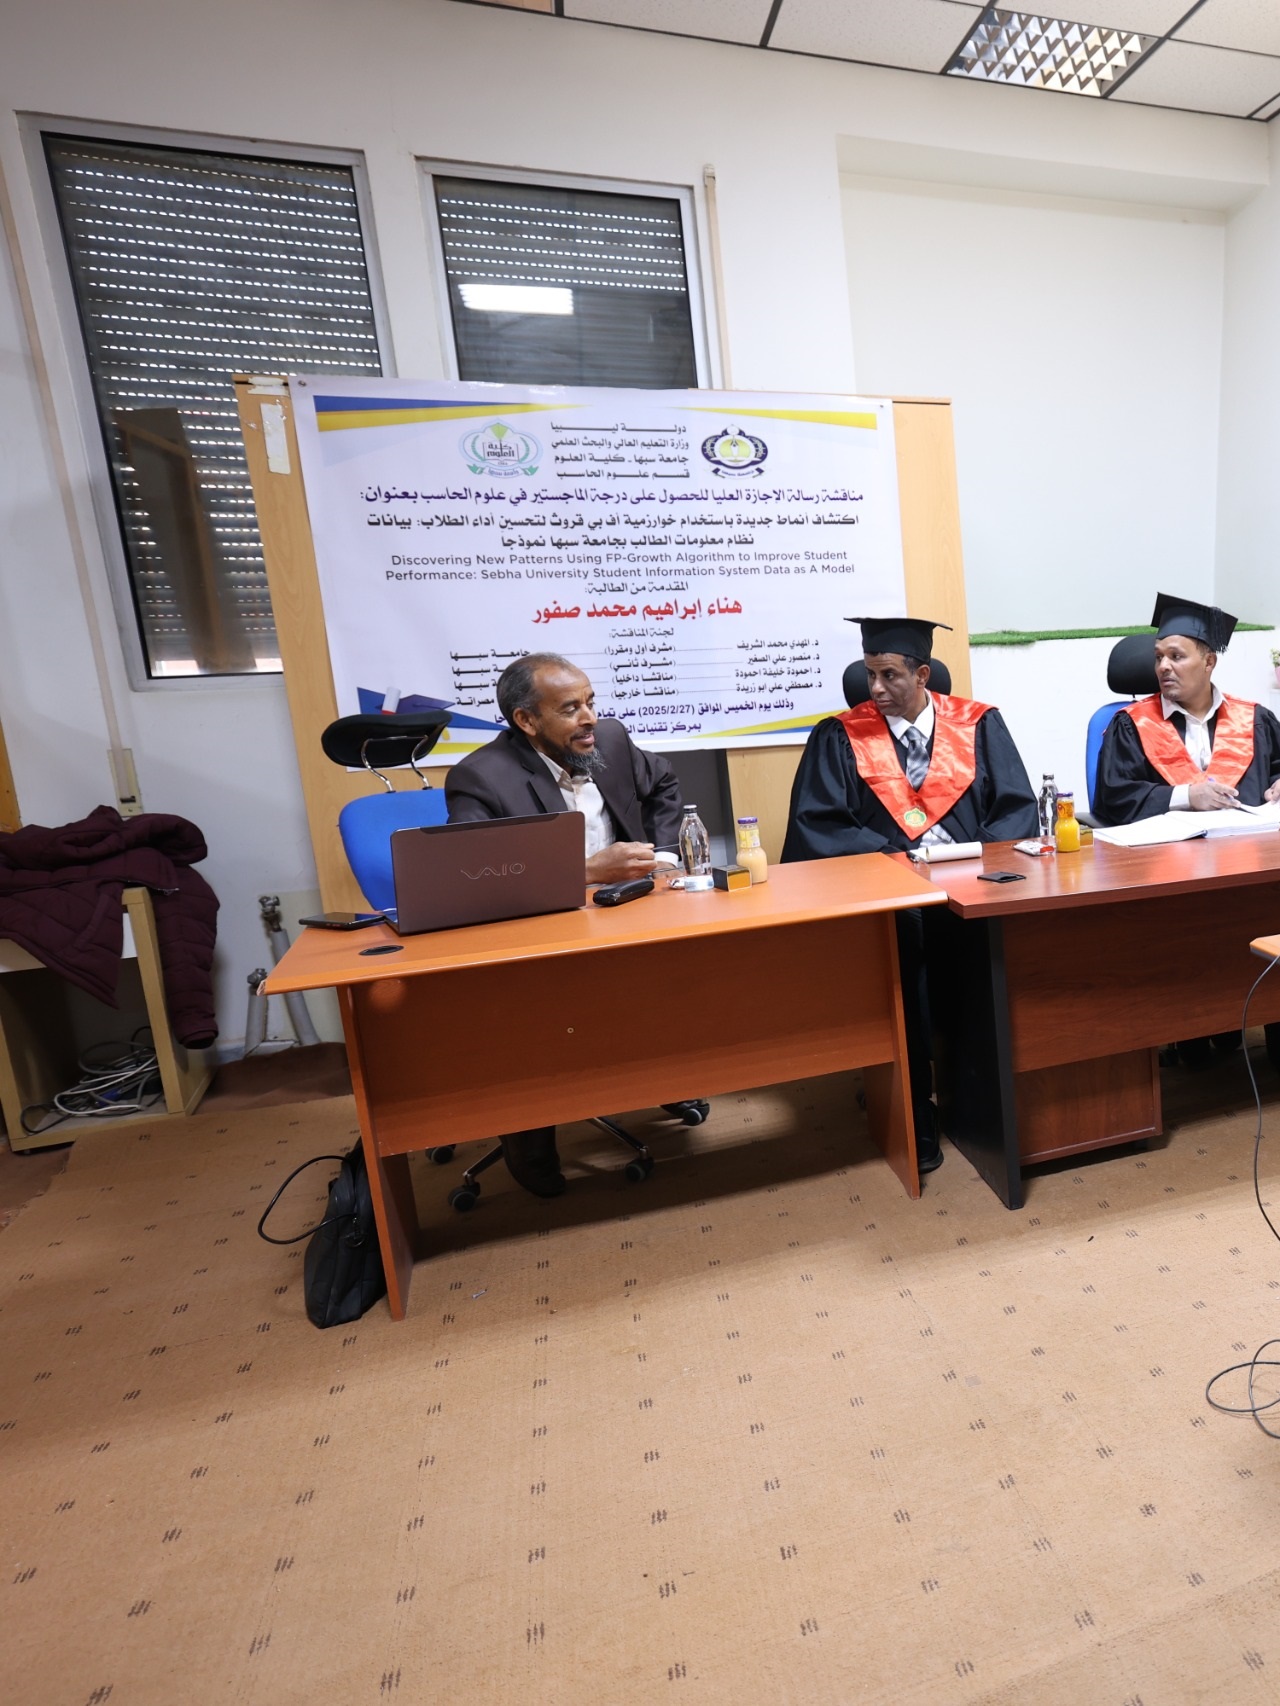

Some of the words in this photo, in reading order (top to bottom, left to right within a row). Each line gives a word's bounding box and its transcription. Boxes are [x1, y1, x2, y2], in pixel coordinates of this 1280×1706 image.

[550, 422, 618, 434] ليبيا
[551, 438, 580, 449] العلمي
[582, 436, 612, 449] والبحث
[614, 439, 638, 450] العالي
[640, 438, 669, 450] التعليم
[670, 438, 689, 450] وزارة
[554, 453, 586, 464] العلوم
[589, 453, 625, 465] كلية
[633, 454, 656, 465] سبها
[659, 453, 689, 466] جامعة
[556, 469, 604, 480] الحاسب
[606, 470, 649, 480] علوم
[652, 469, 690, 480] قسم
[360, 485, 418, 504] بعنوان:
[420, 487, 472, 504] الحاسب
[474, 488, 506, 504] علوم
[509, 488, 527, 507] في
[532, 488, 588, 504] الماجستير
[590, 488, 627, 504] درجة
[630, 489, 656, 505] على
[659, 489, 709, 505] للحصول
[712, 489, 743, 505] العليا
[788, 489, 820, 504] رسالة
[822, 489, 863, 502] مناقشة
[367, 513, 412, 530] بيانات
[417, 514, 469, 530] الطلاب:
[472, 513, 495, 527] أداء
[499, 514, 546, 530] لتحسين
[550, 512, 584, 529] قروث
[587, 518, 603, 531] بي
[623, 514, 676, 529] خوارزمية
[680, 514, 734, 528] باستخدام
[736, 514, 773, 528] جديدة
[776, 514, 809, 525] أنماط
[812, 513, 859, 525] اكتشاف
[550, 536, 579, 550] سبها
[582, 534, 627, 549] بجامعة
[630, 535, 672, 549] الطالب
[674, 534, 724, 548] معلومات
[727, 533, 754, 548] نظام
[391, 554, 472, 567] Discovering
[476, 554, 505, 565] New
[509, 554, 563, 564] Patterns
[567, 553, 602, 565] Using
[606, 553, 672, 563] FP-Growth
[675, 552, 735, 564] Algorithm
[738, 552, 751, 561] to
[754, 552, 801, 562] Improve
[804, 551, 847, 560] Student
[386, 569, 477, 581] Performance:
[481, 569, 522, 580] Sebha
[525, 568, 589, 580] University
[593, 567, 642, 578] Student
[645, 566, 715, 577] Information
[718, 565, 760, 577] System
[763, 565, 790, 575] Data
[793, 566, 806, 574] as
[809, 564, 818, 574] A
[821, 564, 855, 574] Model
[585, 582, 628, 596] الطالبة:
[630, 582, 646, 595] من
[649, 581, 689, 593] المقدمة
[532, 600, 581, 624] صفور
[586, 603, 637, 618] محمد
[642, 598, 701, 621] إبراهيم
[707, 597, 742, 616] هناء
[609, 628, 648, 639] المناقشة:
[650, 627, 674, 638] لجنة
[737, 639, 765, 651] الشريف
[789, 639, 810, 650] المهدي
[450, 651, 489, 662] سبها
[747, 654, 770, 665] الصغير
[772, 654, 786, 665] علي
[788, 653, 811, 663] منصور
[452, 666, 491, 677] سبها
[762, 668, 785, 678] خليفة
[454, 681, 489, 692] سبها
[768, 683, 783, 693] علي
[456, 696, 495, 707] مصراتة
[724, 701, 757, 714] الخميس
[758, 703, 771, 712] يوم
[773, 698, 794, 710] وذلك
[597, 707, 616, 718] تمام
[618, 708, 636, 720] على
[638, 704, 695, 718] (2025/2/27)
[698, 703, 722, 716] الموافق
[637, 722, 668, 735] تقنيات
[670, 721, 702, 734] بمركز
[460, 862, 526, 880] VAIO
